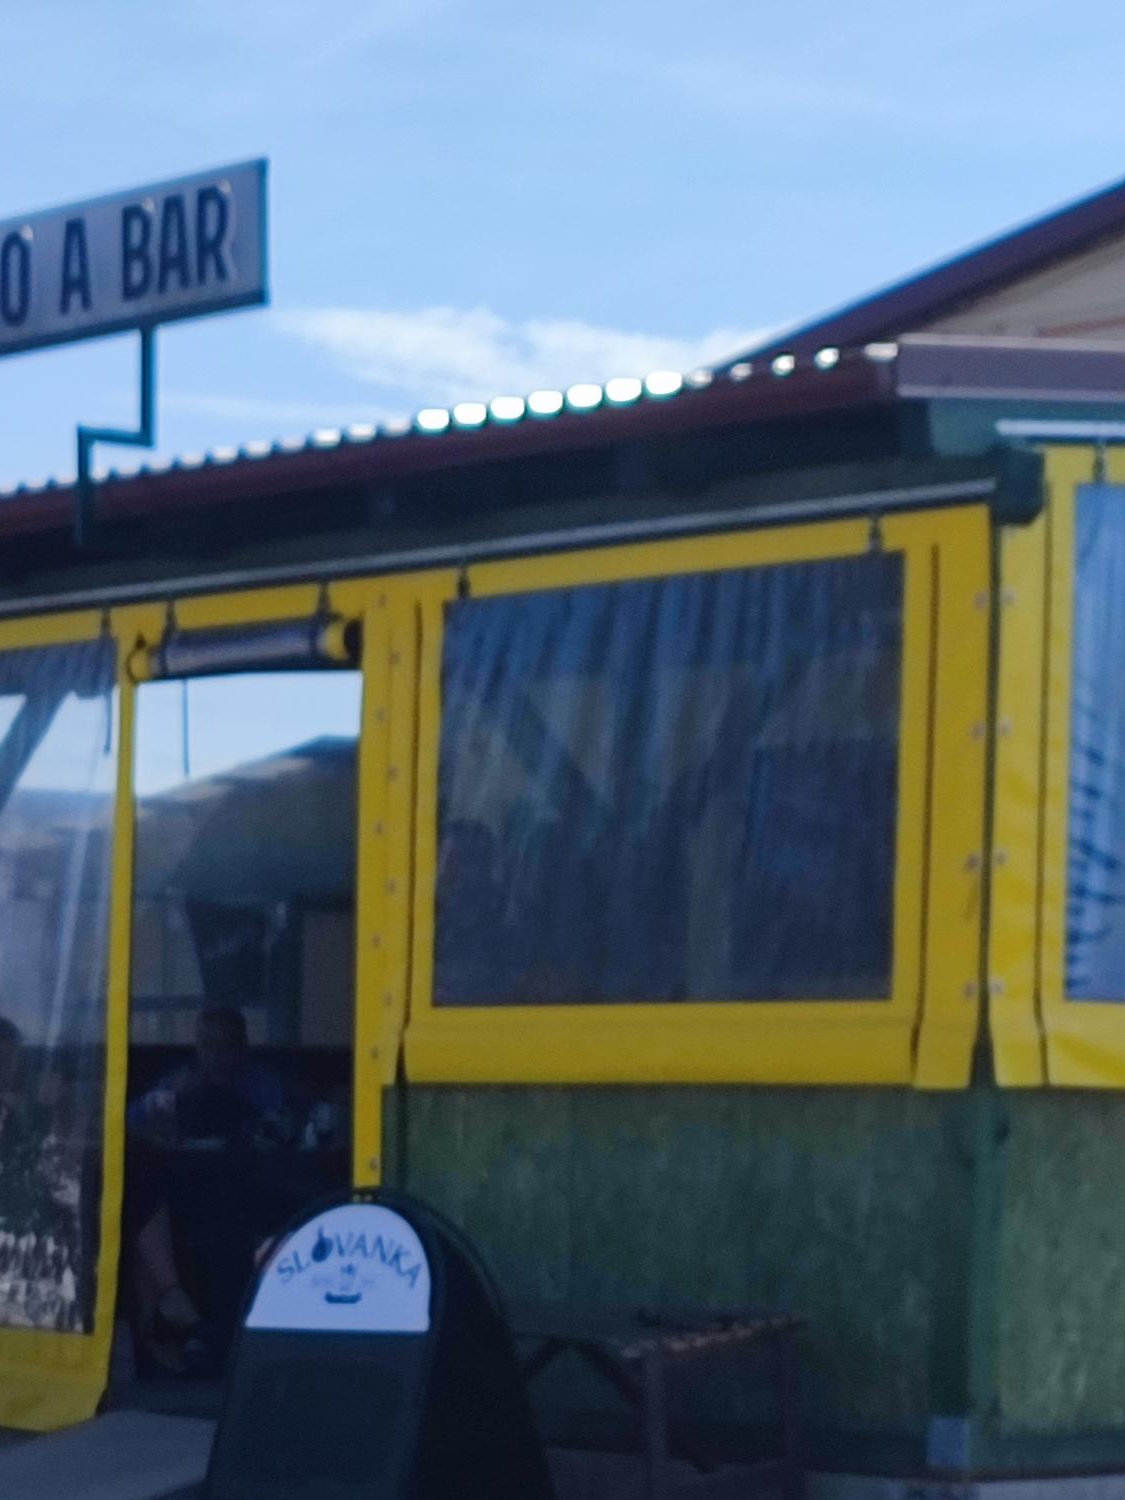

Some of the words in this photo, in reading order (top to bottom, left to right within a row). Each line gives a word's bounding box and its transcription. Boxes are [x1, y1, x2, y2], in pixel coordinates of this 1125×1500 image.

[59, 216, 92, 316] A
[120, 184, 233, 301] BAR
[276, 1228, 422, 1291] SLOVANKA
